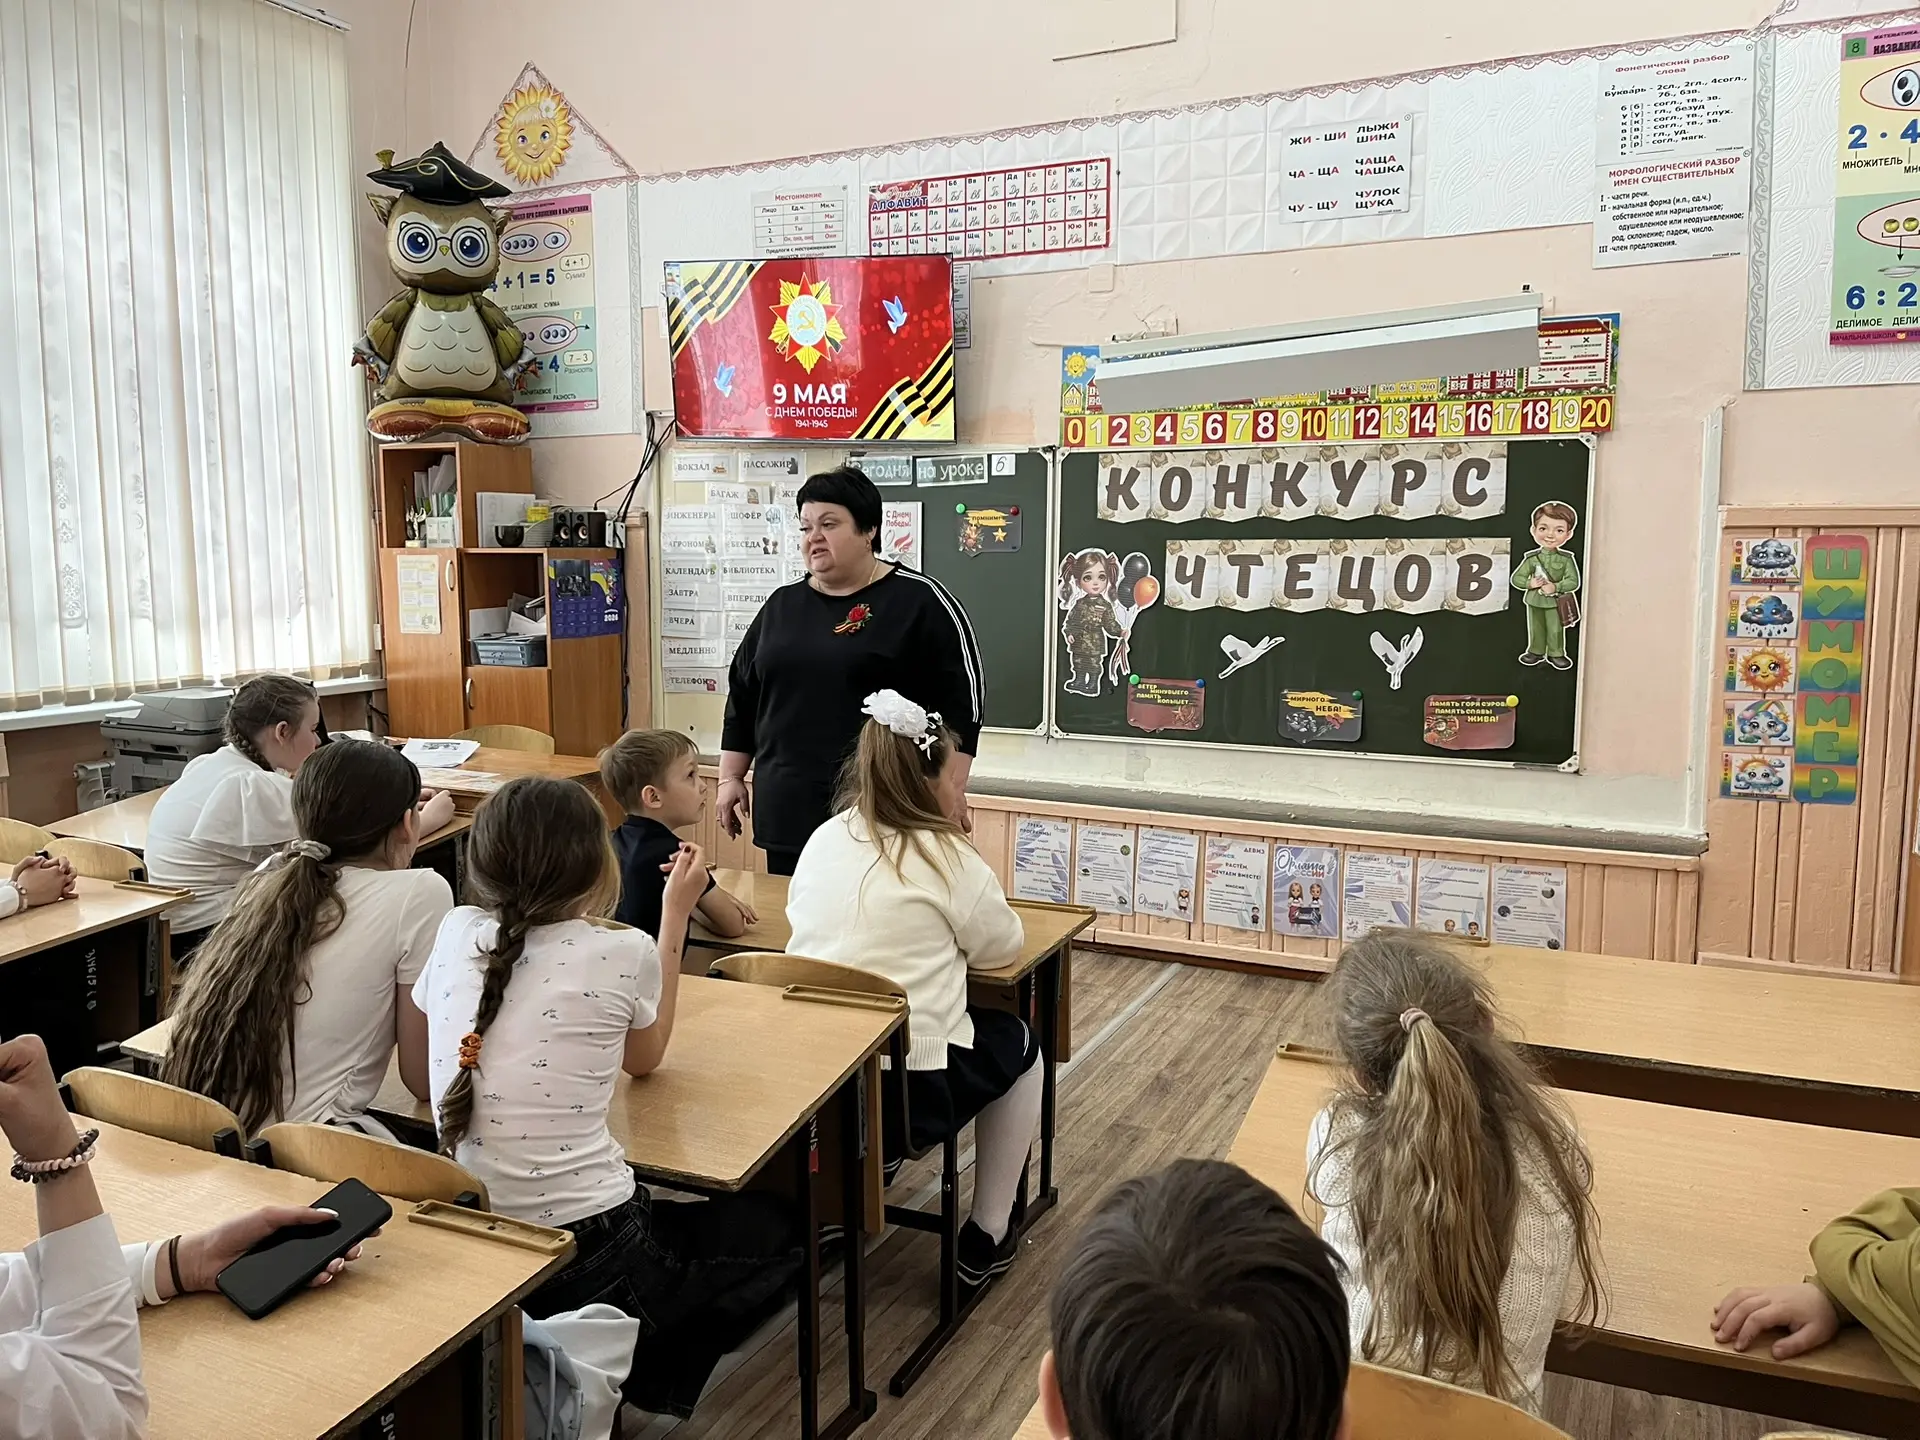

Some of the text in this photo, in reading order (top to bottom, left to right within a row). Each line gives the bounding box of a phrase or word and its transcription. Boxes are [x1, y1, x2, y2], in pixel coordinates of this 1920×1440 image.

[1851, 42, 1860, 54] 8
[1615, 53, 1730, 73] Фонетический разбор
[1655, 67, 1686, 76] слова
[1711, 75, 1748, 85] 4согл.,
[1706, 109, 1734, 118] глух.
[1356, 121, 1400, 134] ЛЫЖИ
[1290, 131, 1347, 146] ЖИ ШИ
[1356, 132, 1396, 144] ШИНА
[1848, 119, 1920, 150] 2 4
[1355, 154, 1397, 166] ЧАЩА
[1842, 156, 1904, 170] МНОЖИТЕЛЬ
[1288, 166, 1340, 179] ЧА ЩА
[1355, 164, 1405, 176] ЧАШКА
[1608, 156, 1741, 178] МОРФОЛОГИЧЕСКИЙ РАЗБОР
[1613, 167, 1735, 188] ИМЕН СУЩЕСТВИТЕЛЬНЫХ
[774, 192, 822, 201] Местоимение
[1355, 187, 1401, 199] ЧУЛОК
[1611, 190, 1649, 201] части речи.
[871, 196, 928, 212] АЛФАВИТ
[1288, 200, 1339, 213] ЧУ ЩУ
[1355, 198, 1395, 210] ЩУКА
[1612, 201, 1648, 212] начальная
[1648, 197, 1672, 208] форма
[1612, 210, 1654, 222] собственное
[1669, 203, 1724, 215] нарицательное;
[1618, 212, 1744, 232] одушевленное или неодушевленное;
[1627, 230, 1665, 241] склонение;
[1666, 228, 1690, 237] падеж,
[1691, 225, 1714, 234] число.
[1629, 239, 1678, 251] предложения.
[517, 268, 555, 289] 1 5
[1846, 282, 1918, 310] 6 2
[1836, 317, 1883, 329] ДЕЛИМОЕ
[1831, 332, 1896, 342] НАЧАЛЬНАЯ ШКОЛА
[549, 354, 560, 373] 4
[772, 383, 847, 404] 9 МАЯ
[765, 406, 858, 419] С ДНЕМ ПОБЕДЫ!
[795, 419, 829, 428] 1941-1945
[1067, 398, 1611, 444] 0 1 2 3 4 5 6 7 8 9 10 11 12 13 14 15 16 17 18 19 20
[995, 455, 1008, 473] 6
[919, 467, 936, 478] на
[1106, 456, 1491, 511] КОНКУРС
[886, 510, 891, 518] С
[665, 567, 716, 576] КАЛЕНДАРЬ
[723, 566, 776, 575] БИБЛИОТЕКА
[1175, 552, 1493, 612] ЧТЕЦОВ
[668, 588, 699, 597] ЗАВТРА
[668, 617, 695, 626] ВЧЕРА
[668, 647, 716, 655] МЕДЛЕННО
[1315, 705, 1342, 713] НЕБА!
[1467, 715, 1499, 723] ЖИВА!
